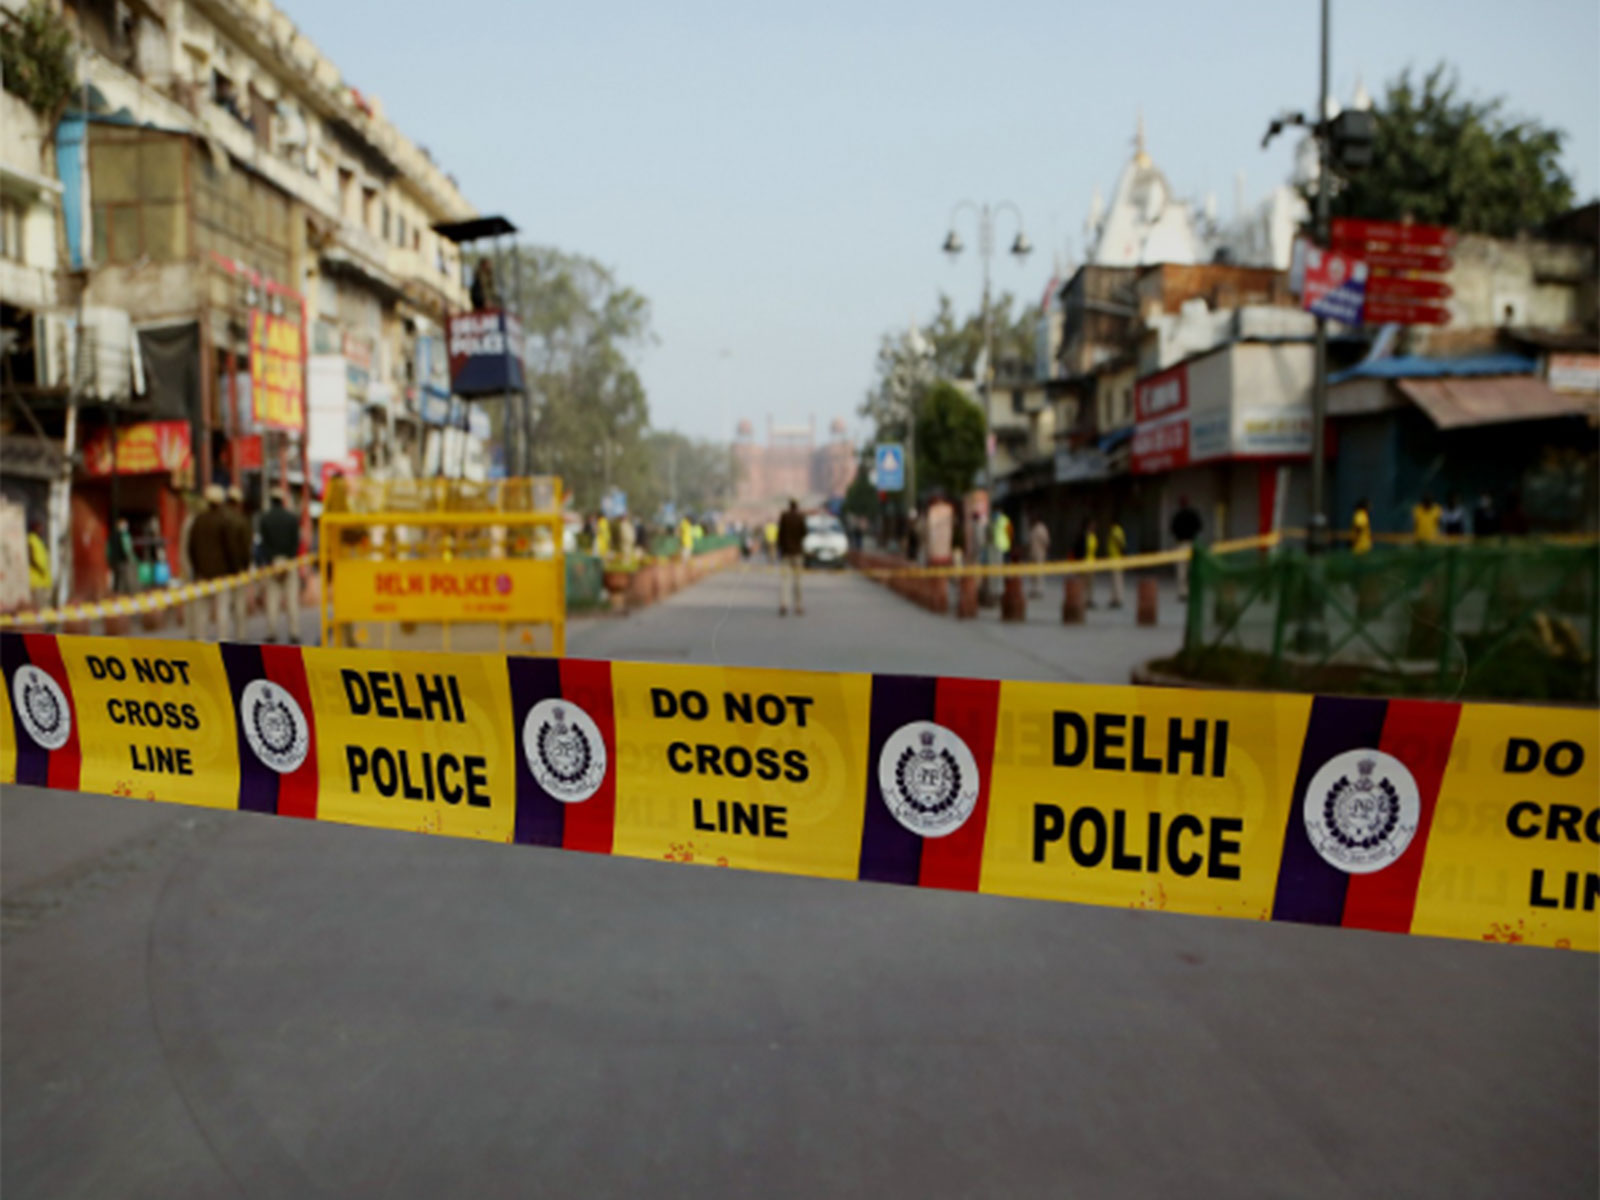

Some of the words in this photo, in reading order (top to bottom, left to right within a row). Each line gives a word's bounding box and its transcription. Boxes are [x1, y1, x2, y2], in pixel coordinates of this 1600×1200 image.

[375, 572, 424, 597] DELHI
[429, 572, 492, 597] POLICE
[86, 655, 127, 682] DO
[131, 657, 190, 686] NOT
[107, 698, 200, 731] CROSS
[341, 668, 466, 724] DELHI
[650, 687, 709, 721] DO
[723, 691, 815, 728] NOT
[130, 744, 193, 776] LINE
[667, 741, 809, 783] CROSS
[1053, 710, 1230, 778] DELHI
[1504, 737, 1586, 778] DO
[346, 744, 491, 808] POLICE
[693, 798, 788, 839] LINE
[1033, 803, 1244, 881] POLICE
